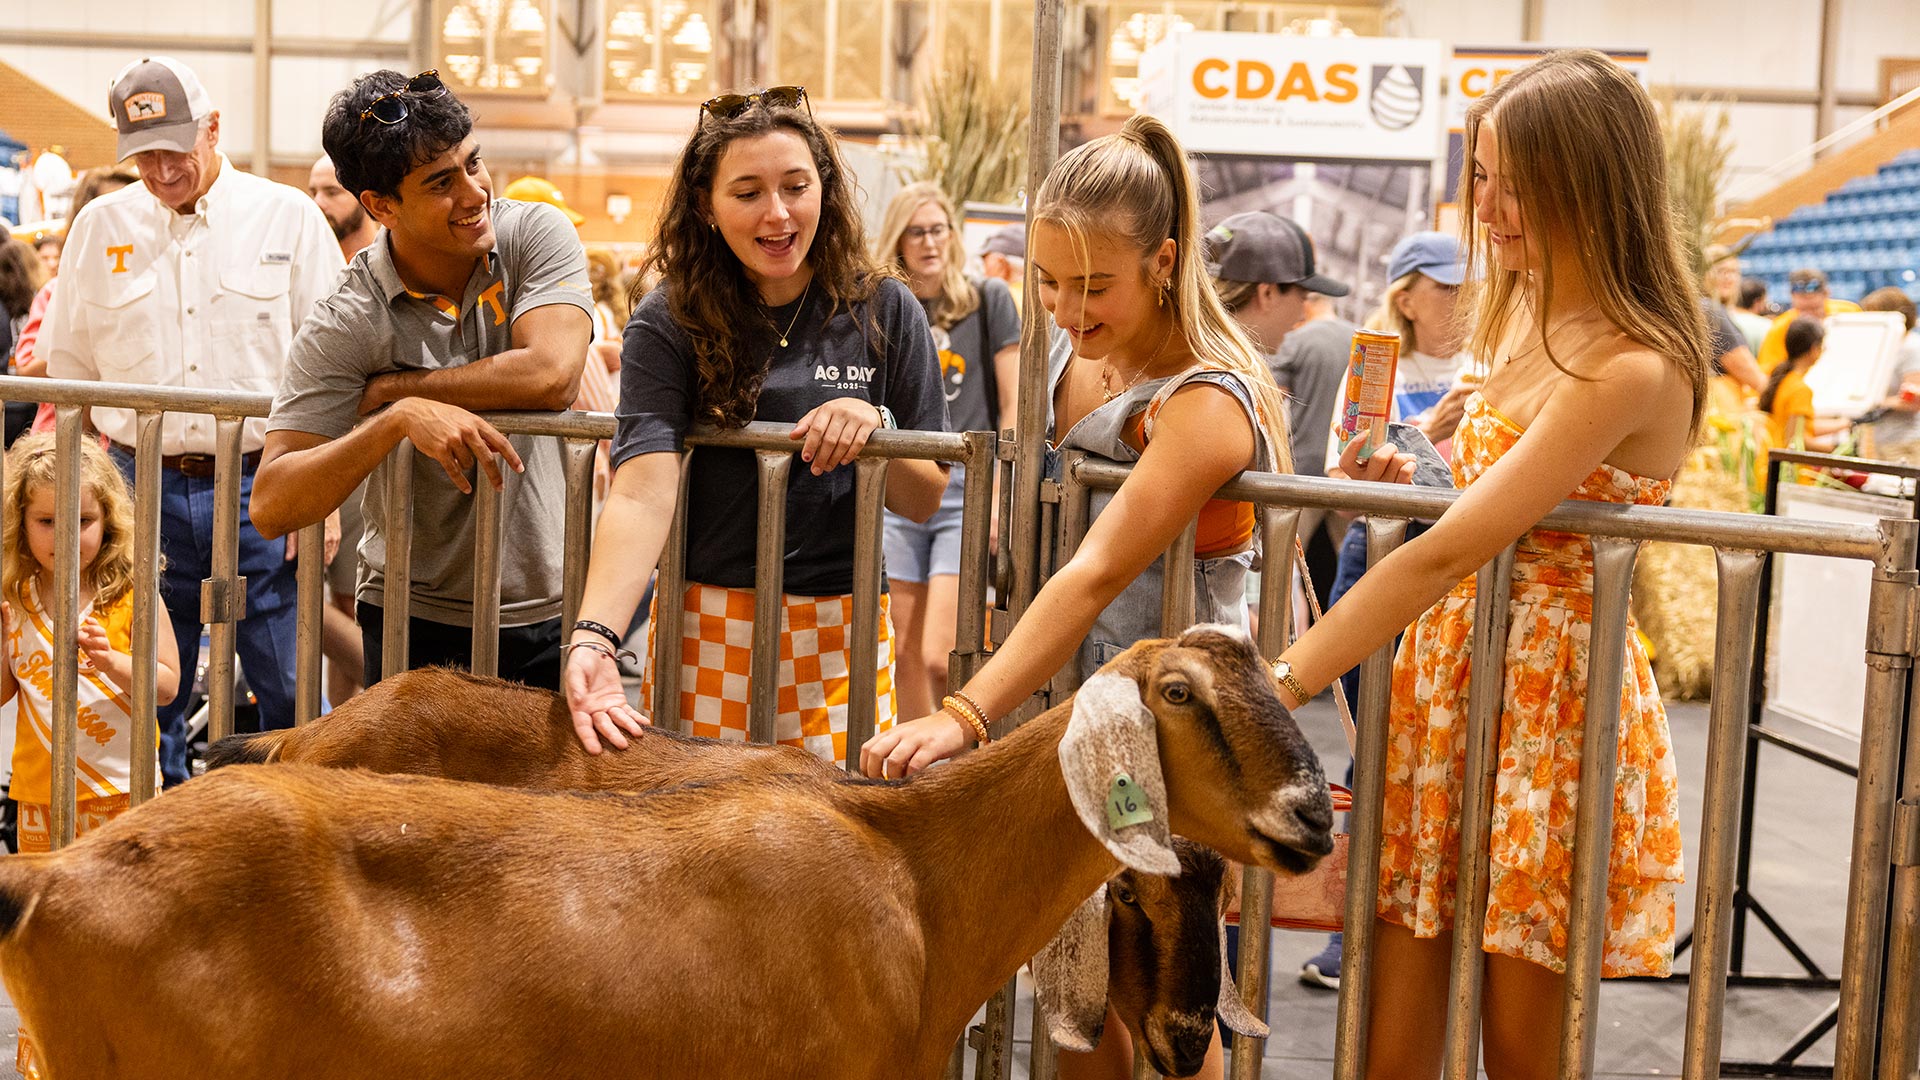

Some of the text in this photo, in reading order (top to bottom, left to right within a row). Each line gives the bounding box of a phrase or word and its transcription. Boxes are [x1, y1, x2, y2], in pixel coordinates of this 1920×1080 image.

[1192, 58, 1359, 103] CDAS
[107, 245, 133, 273] T
[478, 280, 506, 326] T
[814, 365, 876, 382] AG DAY
[1115, 796, 1137, 816] 16
[26, 833, 44, 841] VOLS
